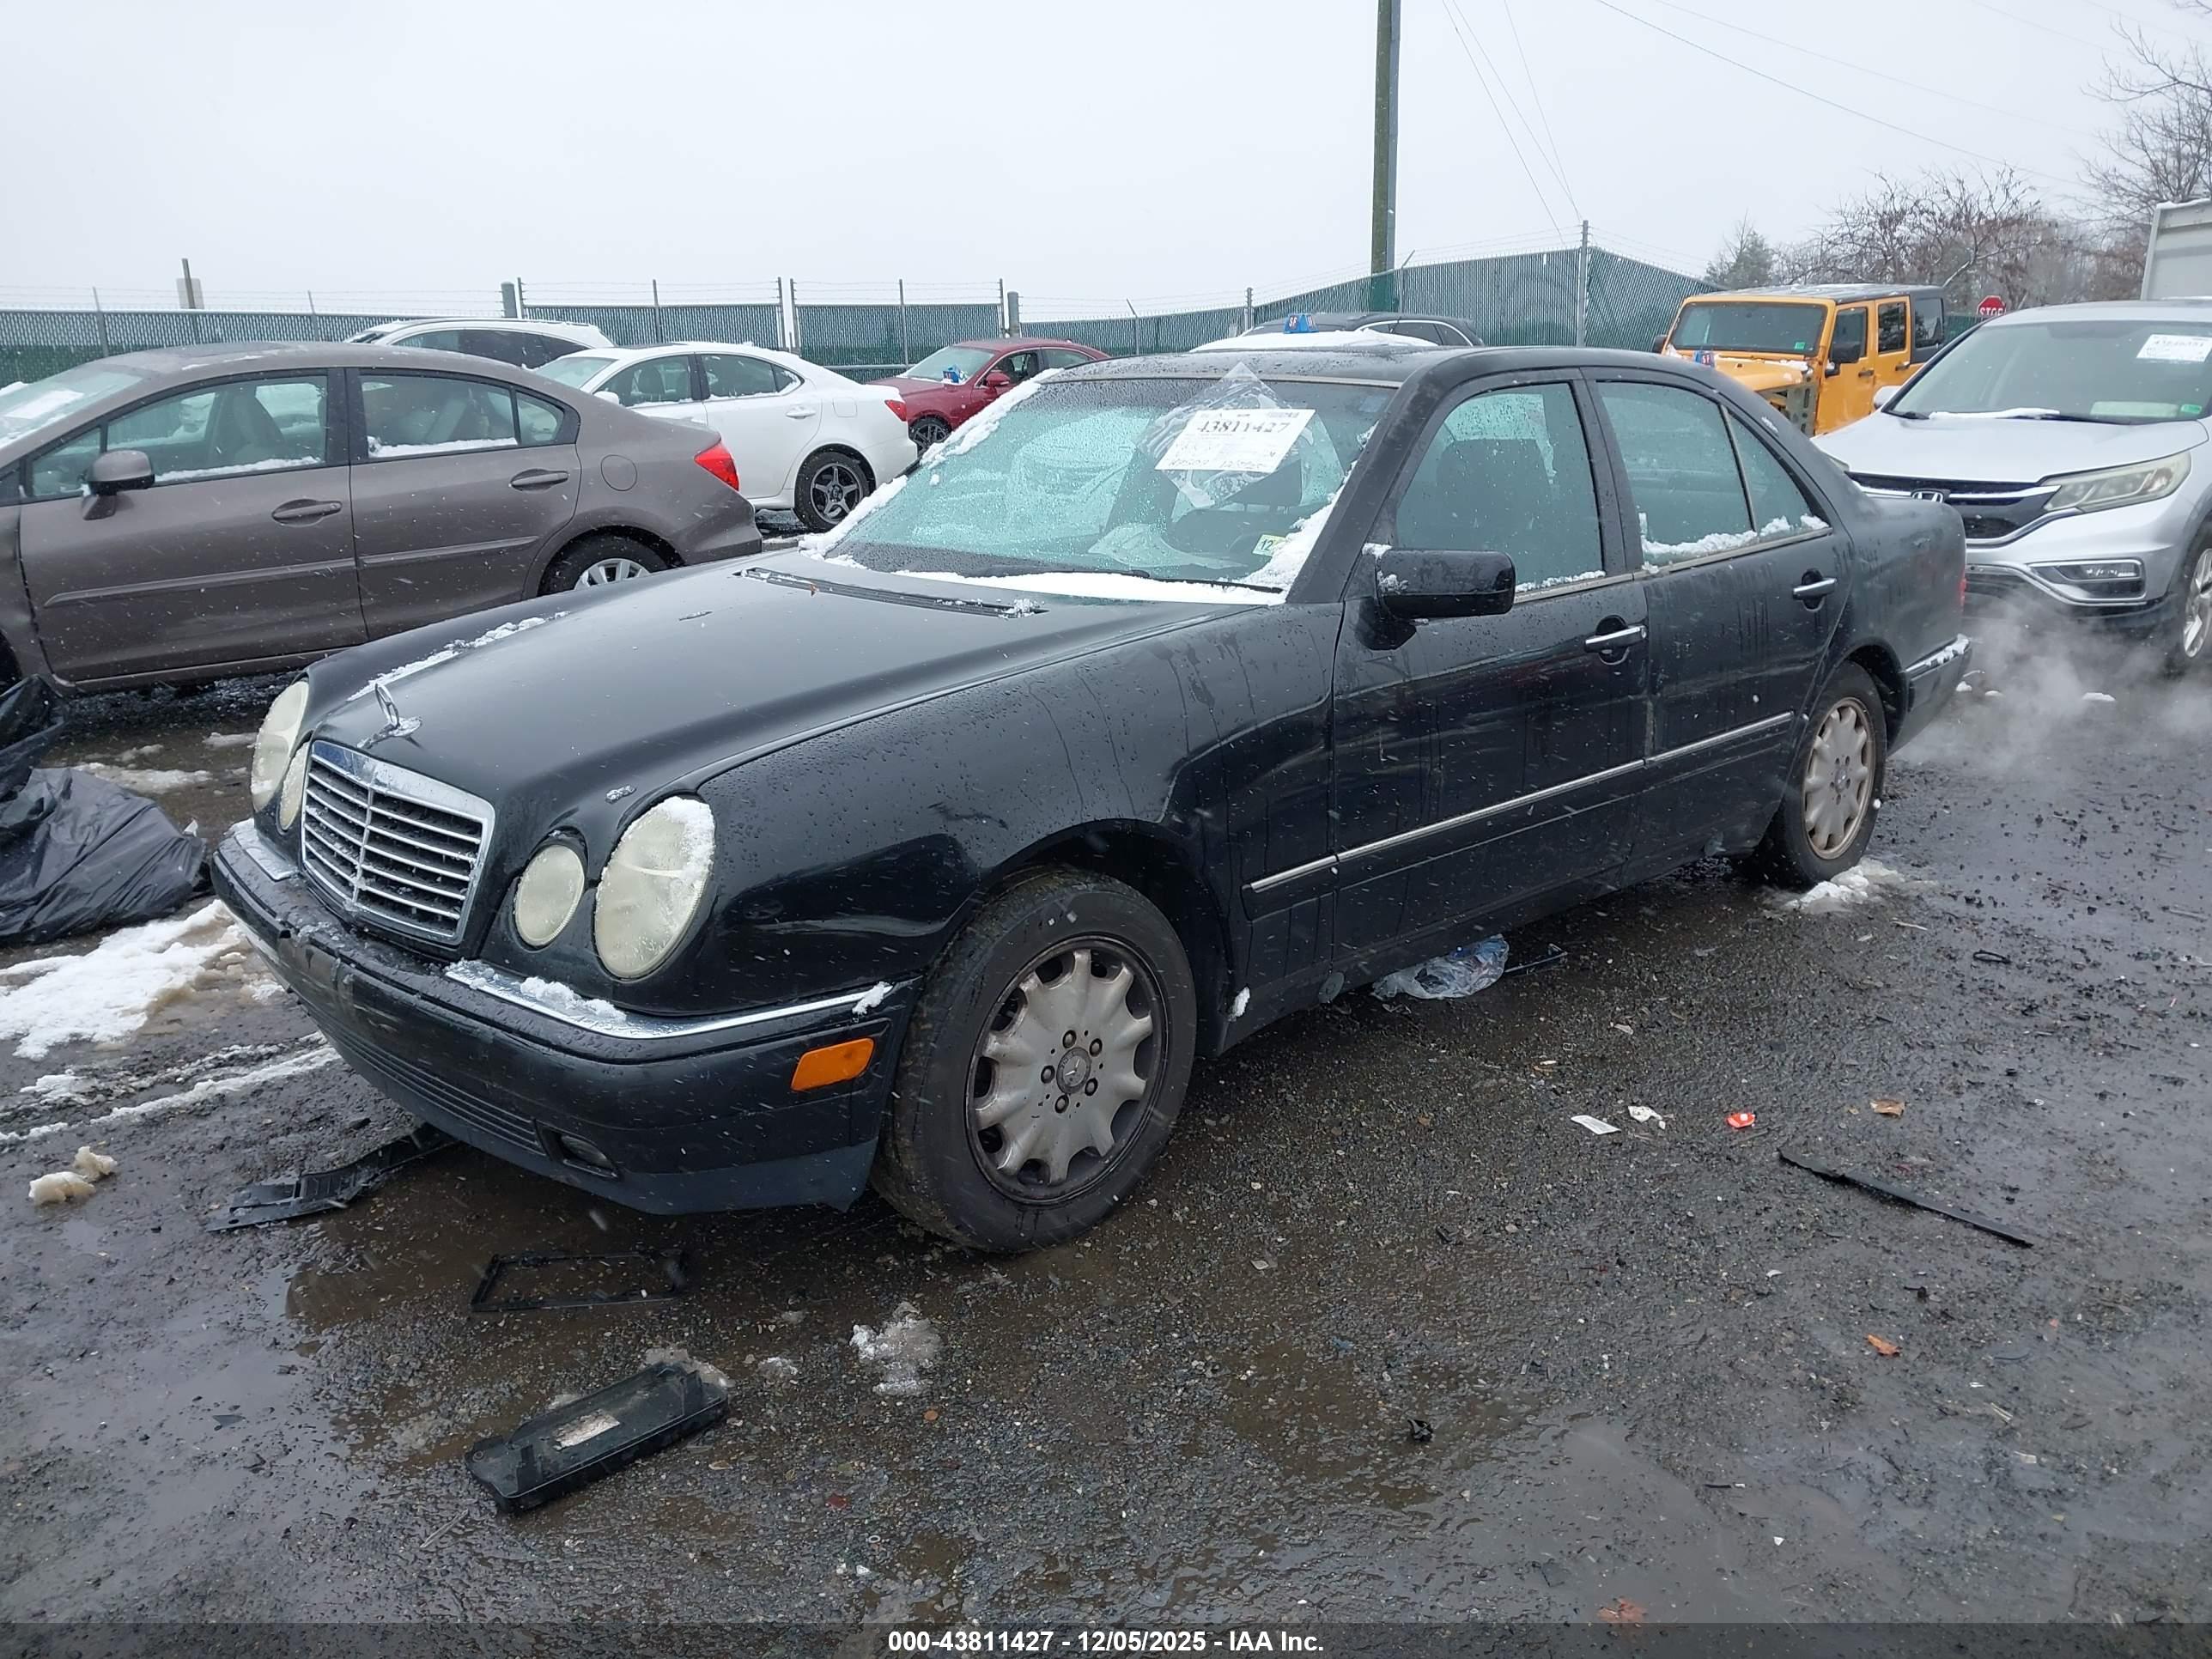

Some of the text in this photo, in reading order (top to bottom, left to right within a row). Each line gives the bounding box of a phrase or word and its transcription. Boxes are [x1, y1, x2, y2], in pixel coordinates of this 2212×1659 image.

[1979, 307, 2003, 316] STOP
[1197, 420, 1290, 433] 43811427
[1260, 538, 1273, 550] 12
